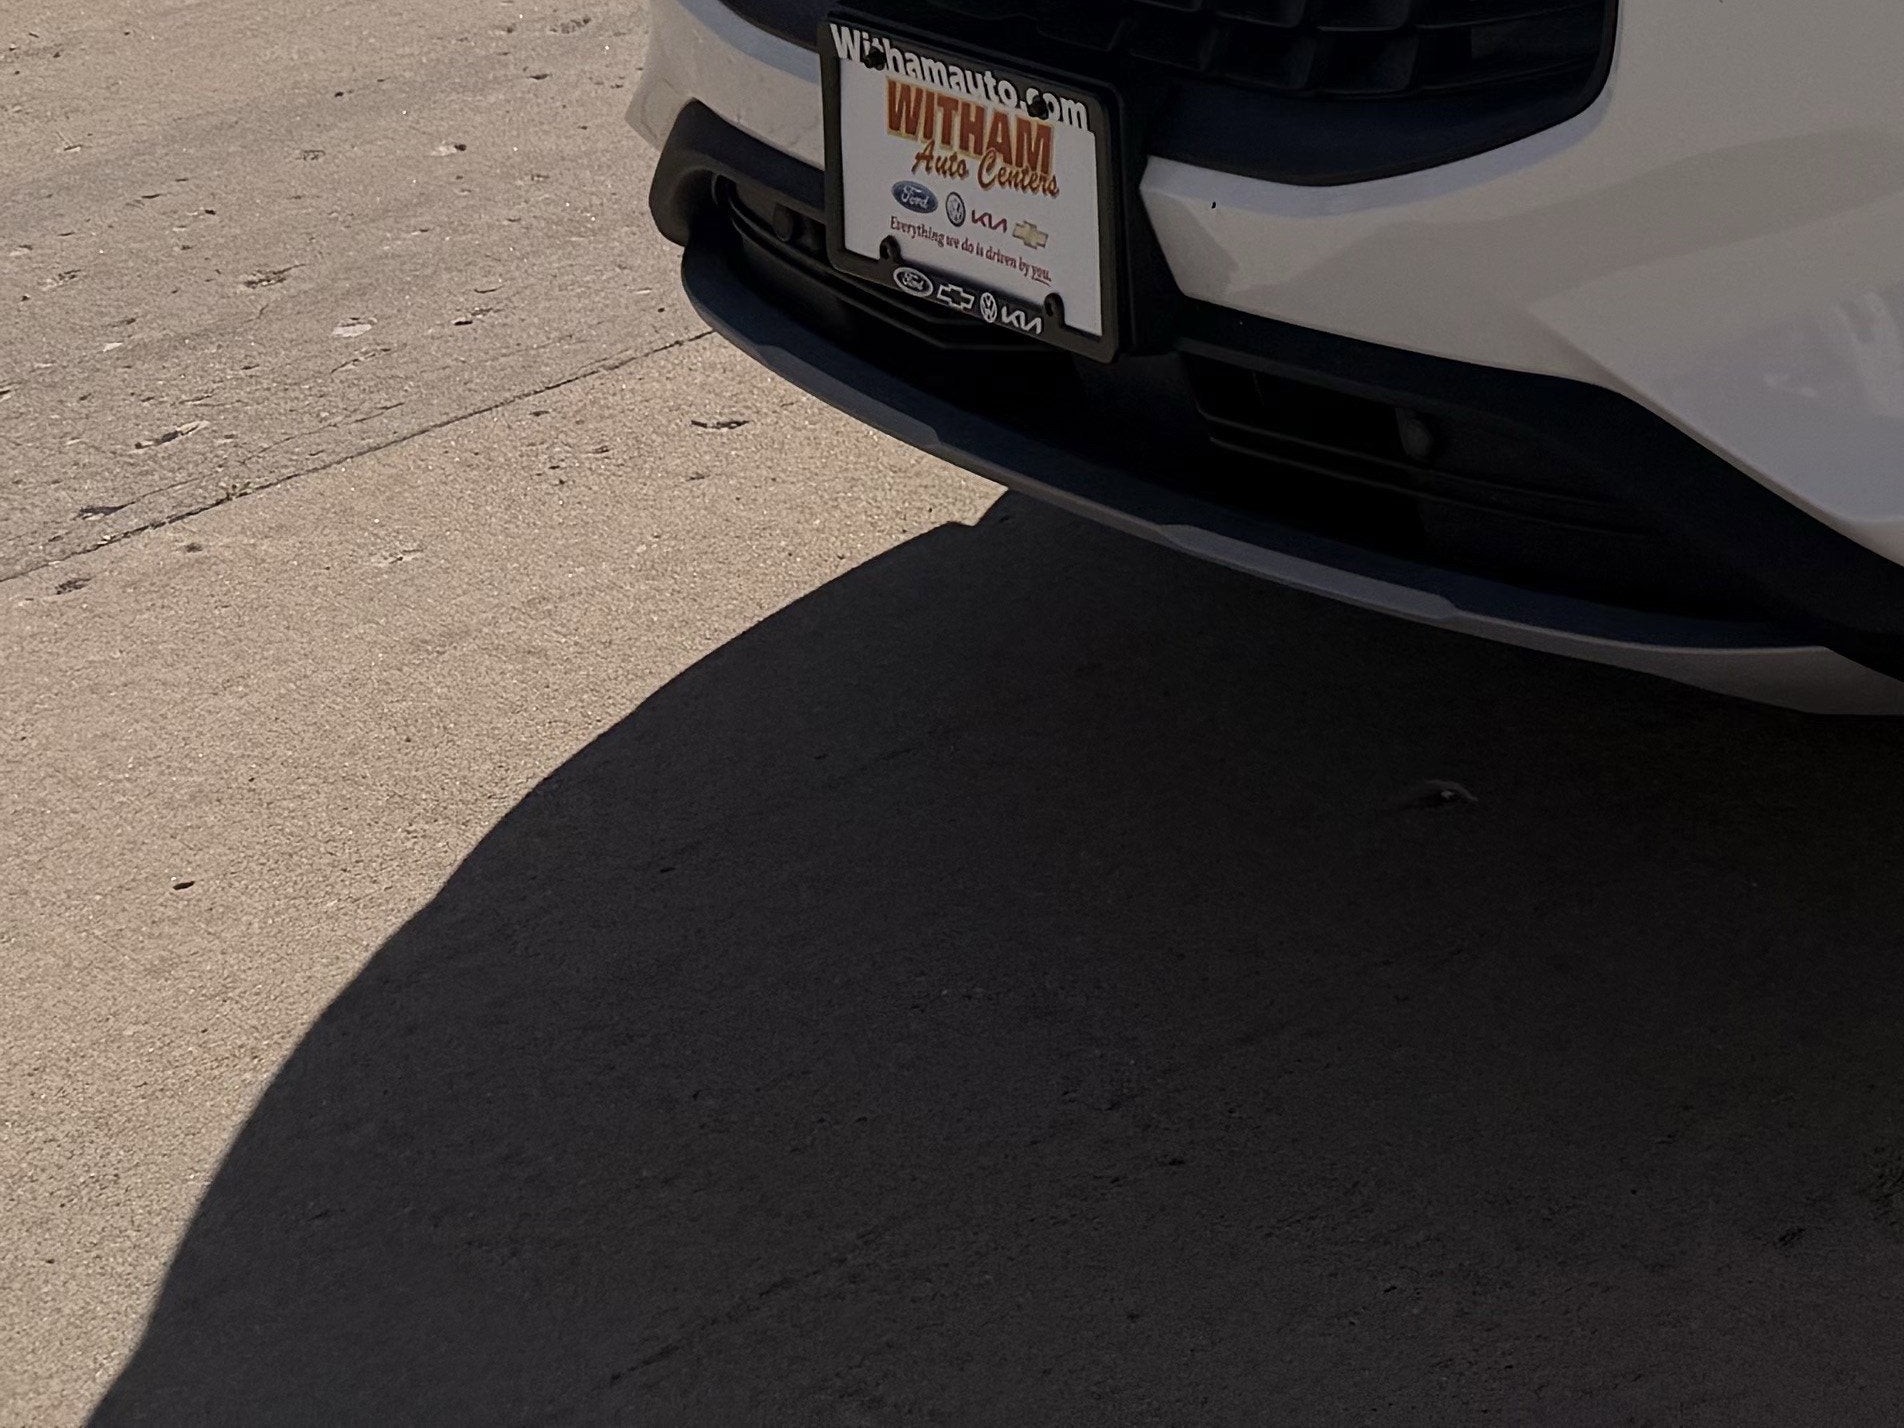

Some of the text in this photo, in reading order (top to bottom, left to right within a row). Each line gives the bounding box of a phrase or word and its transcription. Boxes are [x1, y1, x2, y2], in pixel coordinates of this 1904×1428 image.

[885, 76, 1054, 175] WITHAM
[911, 140, 1060, 198] Auto Centers
[890, 215, 945, 248] Everything
[946, 235, 961, 249] we
[962, 238, 975, 254] do
[976, 243, 984, 258] is
[985, 246, 1017, 271] driven
[1019, 256, 1031, 278] by
